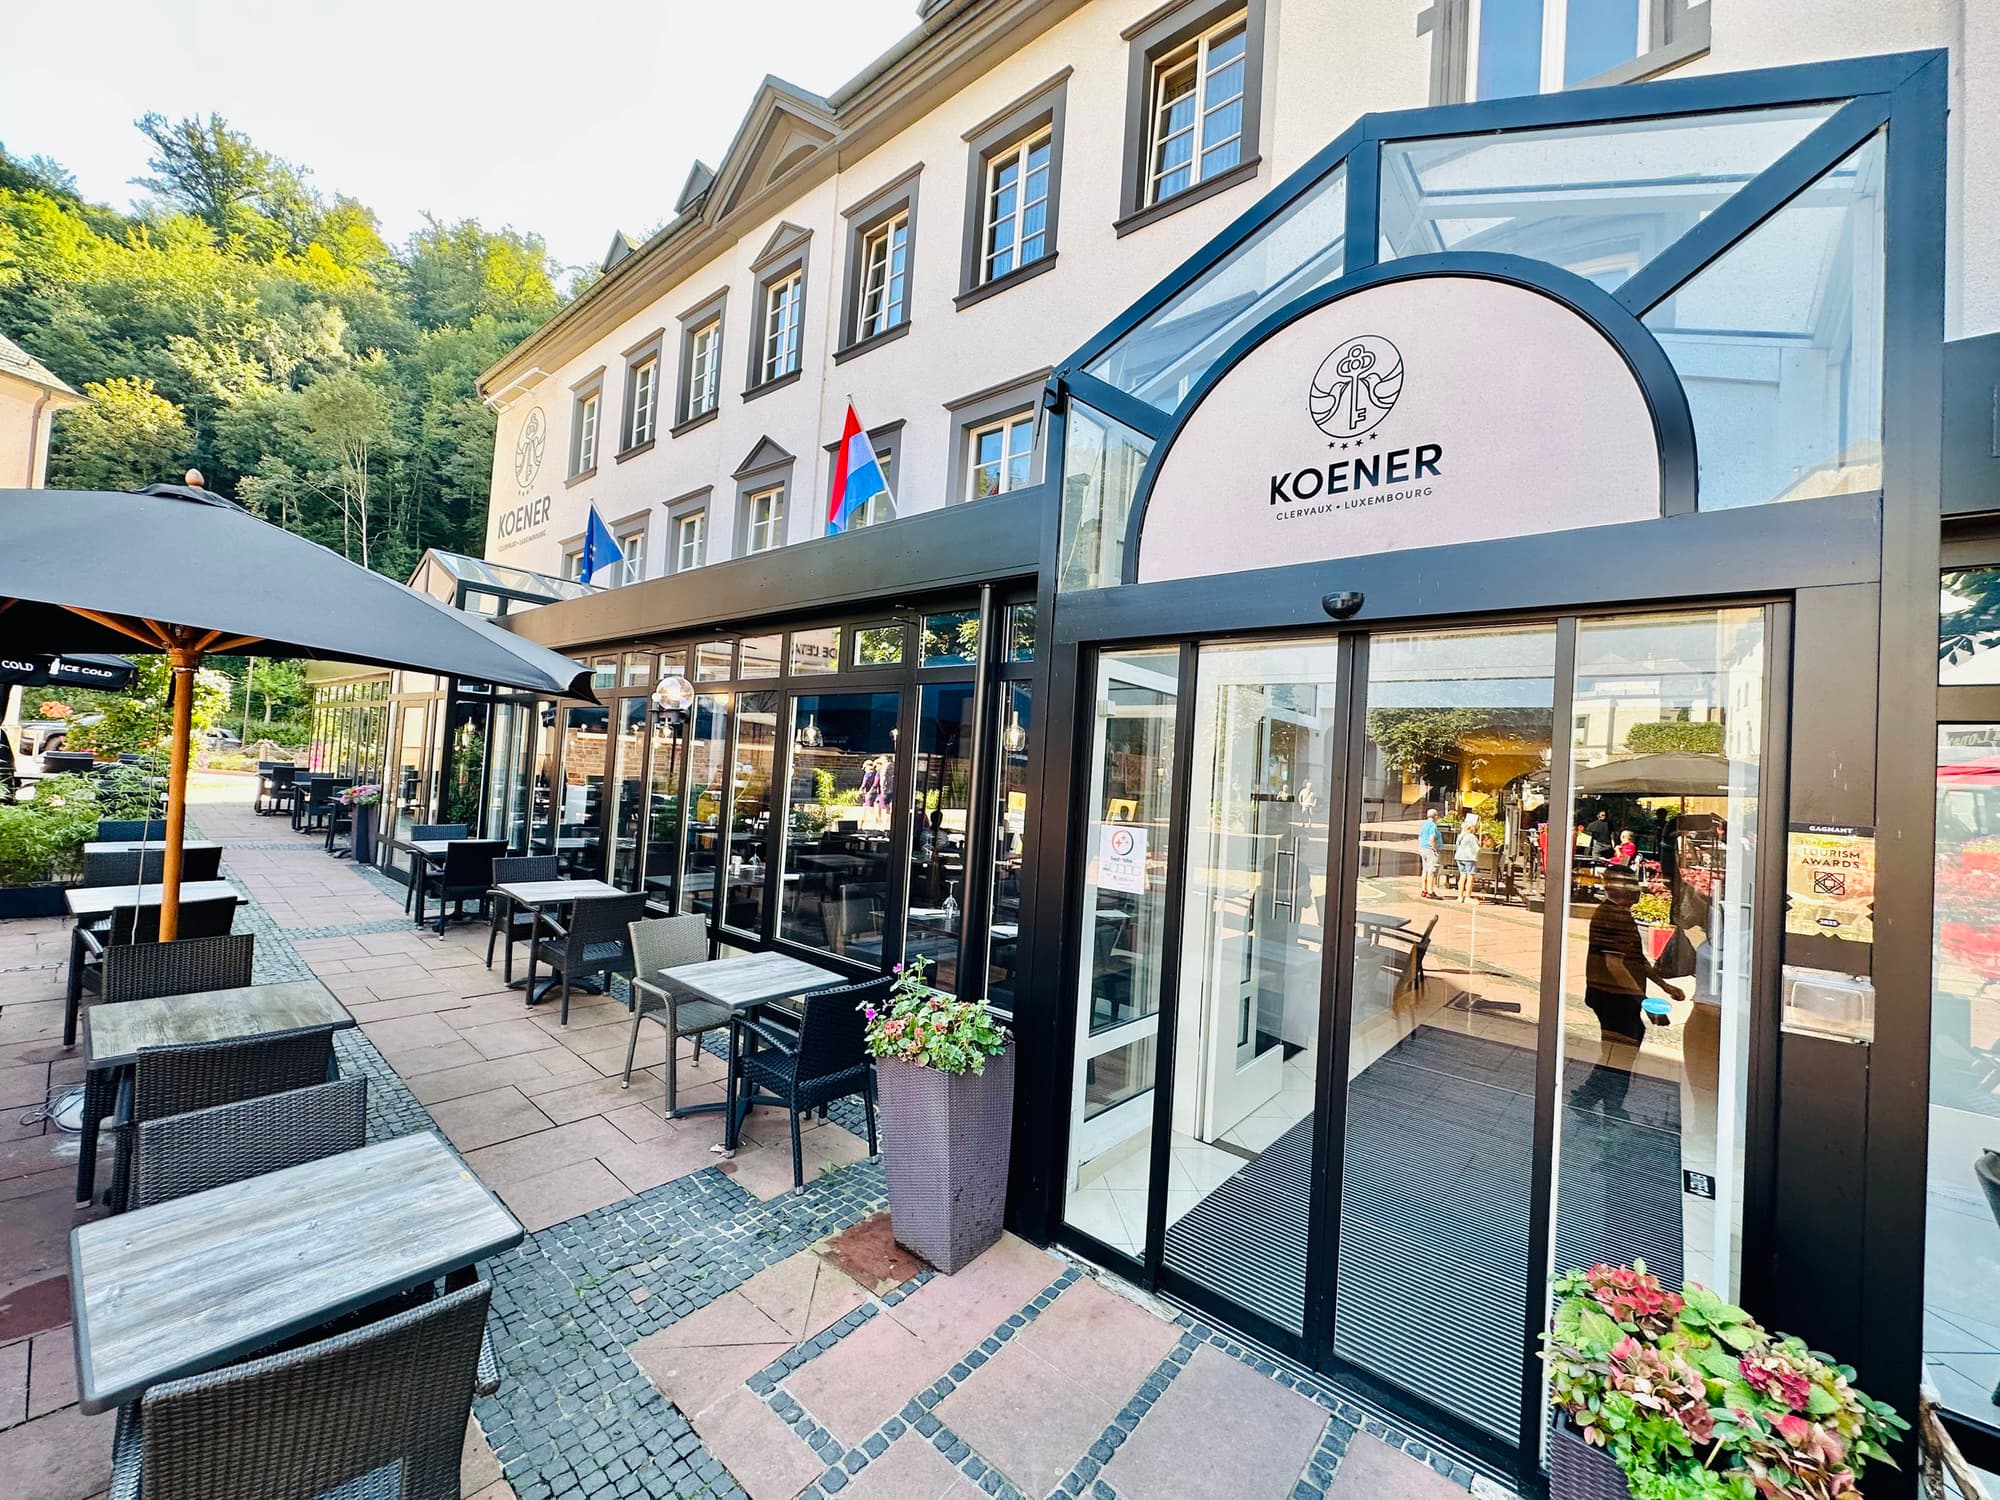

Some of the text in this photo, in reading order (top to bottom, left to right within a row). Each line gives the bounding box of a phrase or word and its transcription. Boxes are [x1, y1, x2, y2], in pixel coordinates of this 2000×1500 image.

[1270, 443, 1443, 506] KOENER
[1276, 487, 1433, 521] CLERVAUX LUXEMBOURG
[498, 496, 551, 540] KOENER
[1, 659, 34, 672] COLD
[61, 663, 113, 678] ICE COLD
[1808, 825, 1854, 834] GAGNANT
[1802, 848, 1860, 859] TOURISM
[1801, 858, 1860, 868] AWARDS
